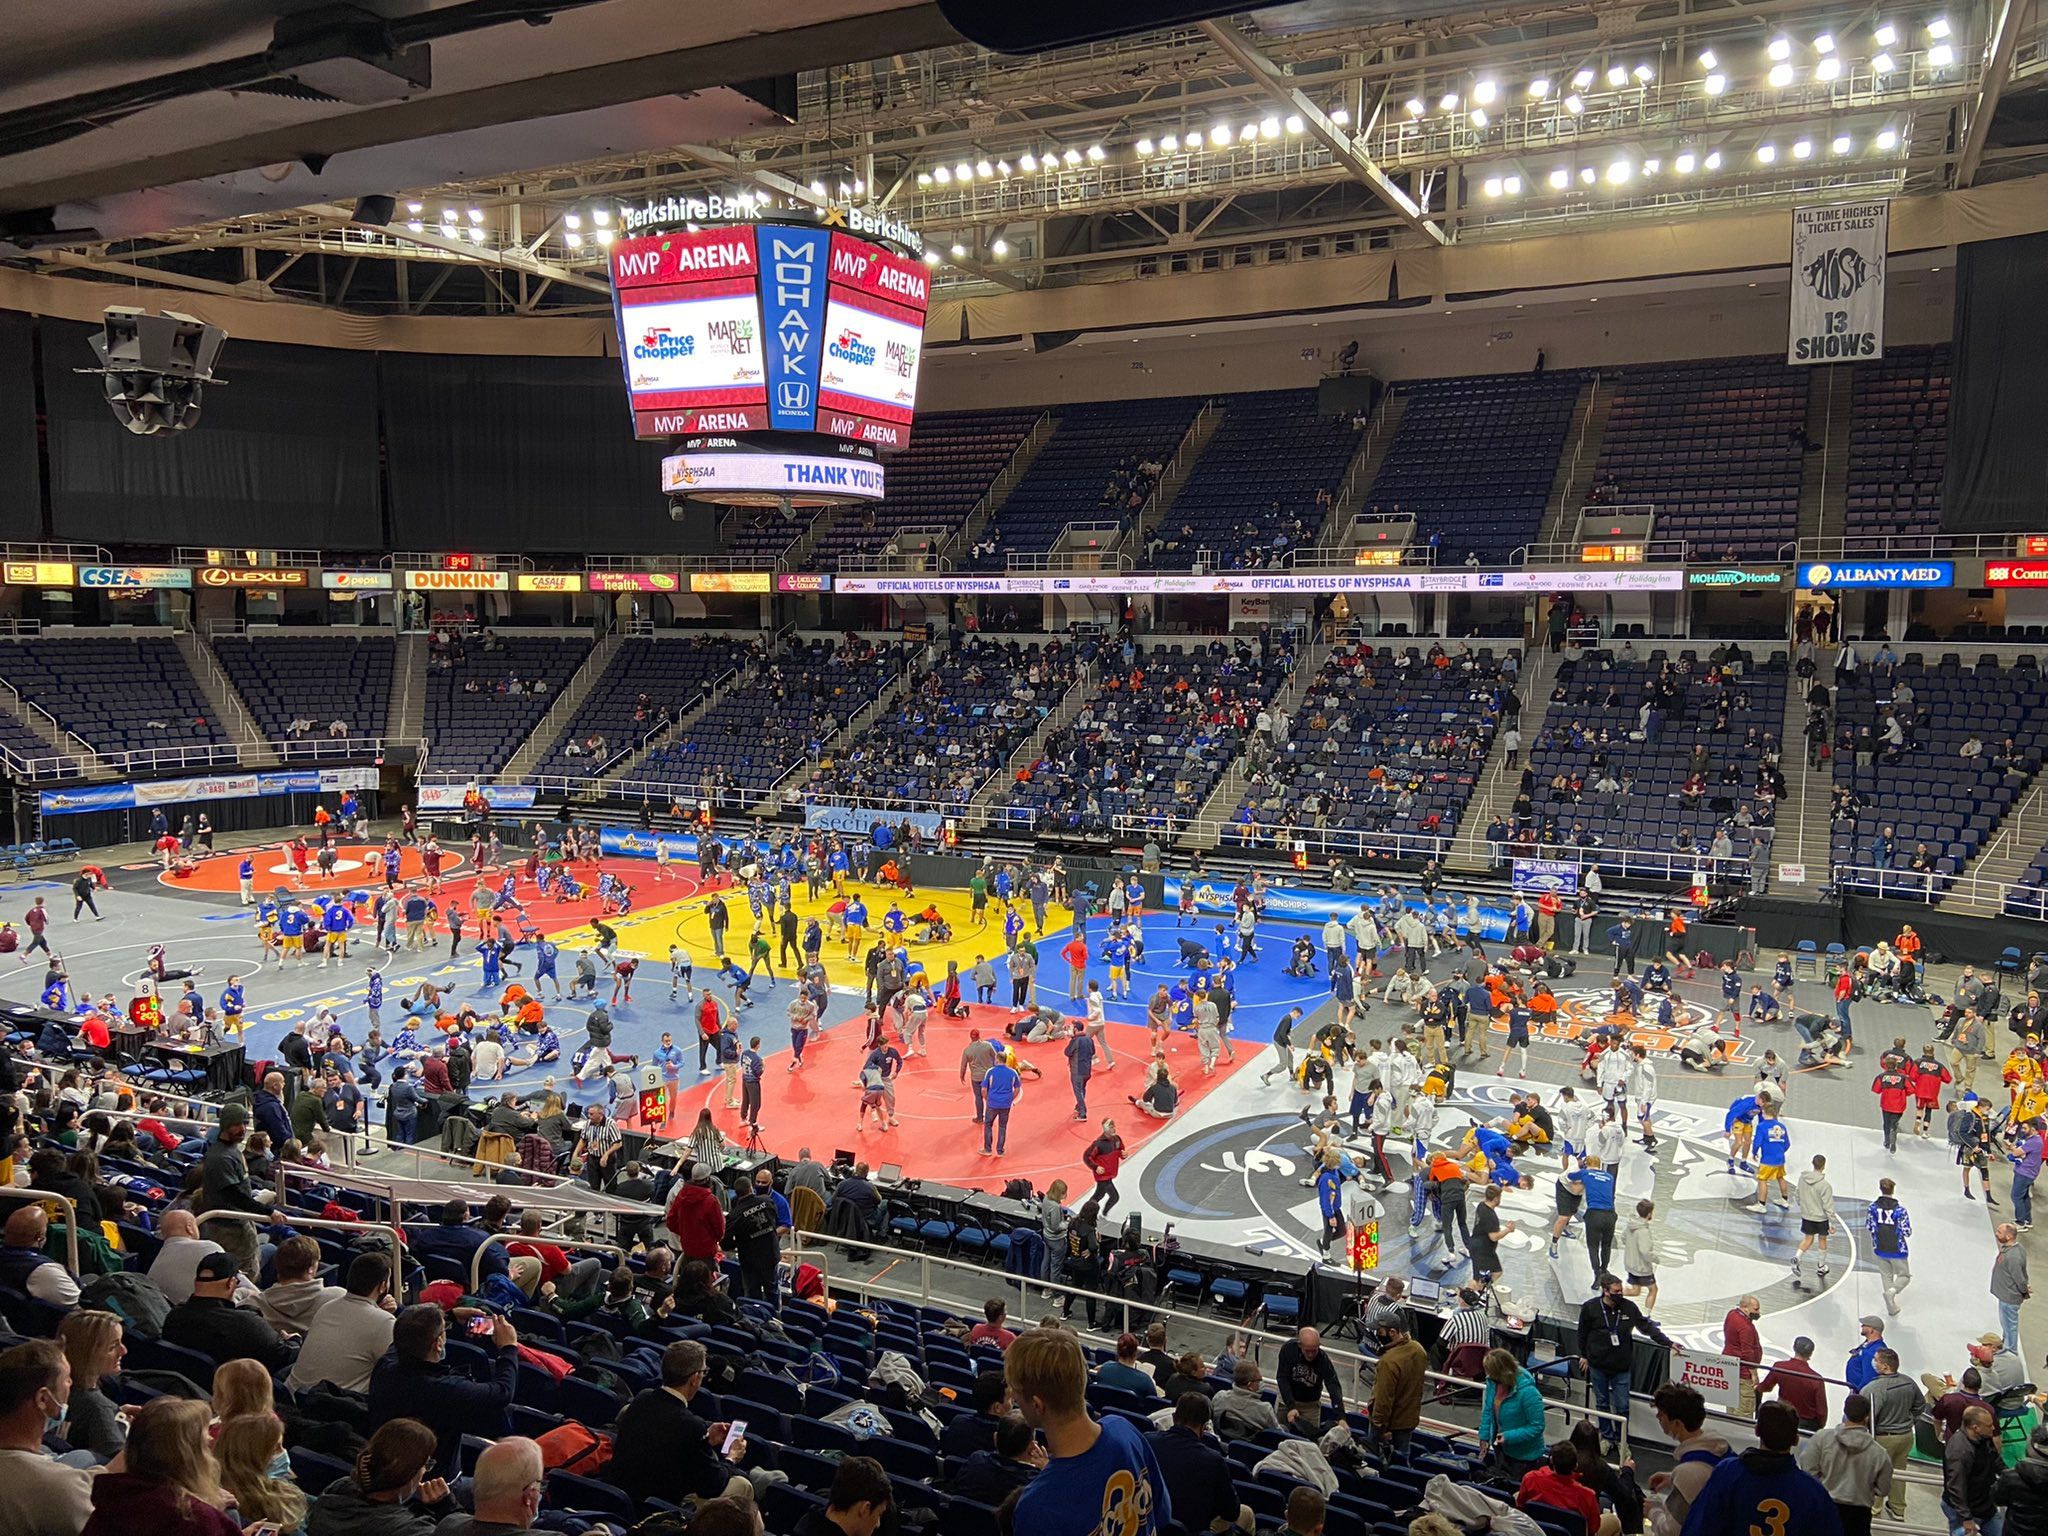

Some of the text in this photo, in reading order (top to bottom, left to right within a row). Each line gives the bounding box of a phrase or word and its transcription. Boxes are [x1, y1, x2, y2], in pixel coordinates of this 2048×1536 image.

[626, 195, 762, 229] BerkshireBank
[1796, 205, 1885, 224] ALL TIME HIGHEST
[1808, 218, 1875, 234] TICKET SALES
[619, 242, 751, 277] MVP ARENA
[834, 248, 925, 300] MVP ARENA
[773, 239, 815, 375] MOHAWK
[1824, 311, 1848, 334] 13
[659, 333, 695, 347] Price
[1795, 332, 1876, 360] SHOWS
[634, 345, 695, 359] Chopper
[829, 342, 875, 366] Chopper
[850, 338, 876, 357] Price
[777, 409, 810, 417] HONDA
[654, 413, 749, 432] MVP ARENA
[831, 417, 897, 444] MVP ARENA
[687, 438, 737, 448] MVP ARENA
[839, 444, 874, 457] MVP ARENA
[676, 466, 715, 477] NYSPHSAA
[784, 464, 848, 486] THANK
[851, 468, 875, 487] YOU
[83, 568, 142, 586] CSEA
[230, 572, 302, 582] LEXUS
[351, 576, 378, 585] pepsi
[415, 573, 500, 588] DUNKIN'
[532, 577, 566, 585] CASALE
[1690, 572, 1780, 584] MOHAWK Honda
[1834, 568, 1941, 582] ALBANY MED
[604, 580, 642, 591] health.
[877, 580, 1000, 590] OFFICIAL HOTELS OF NYSPHSAA
[1252, 578, 1411, 588] OFFICIAL HOTELS OF NYSPHSAA
[209, 783, 226, 794] BASE
[1199, 891, 1236, 902] NYSPHSA
[287, 914, 295, 924] 3
[335, 910, 343, 920] 3
[142, 984, 149, 994] 8
[1197, 976, 1206, 988] 3
[140, 1003, 146, 1011] 0
[1180, 1002, 1189, 1012] 3
[648, 1073, 656, 1084] 9
[646, 1095, 665, 1107] 0 0
[743, 1201, 767, 1217] BOBCAT
[1359, 1205, 1374, 1220] 10
[1877, 1208, 1894, 1225] IX
[1366, 1222, 1377, 1235] 69
[1360, 1232, 1378, 1246] 0 0
[1685, 1361, 1724, 1378] FLOOR
[1681, 1372, 1729, 1390] ACCESS
[1749, 1498, 1791, 1536] 3
